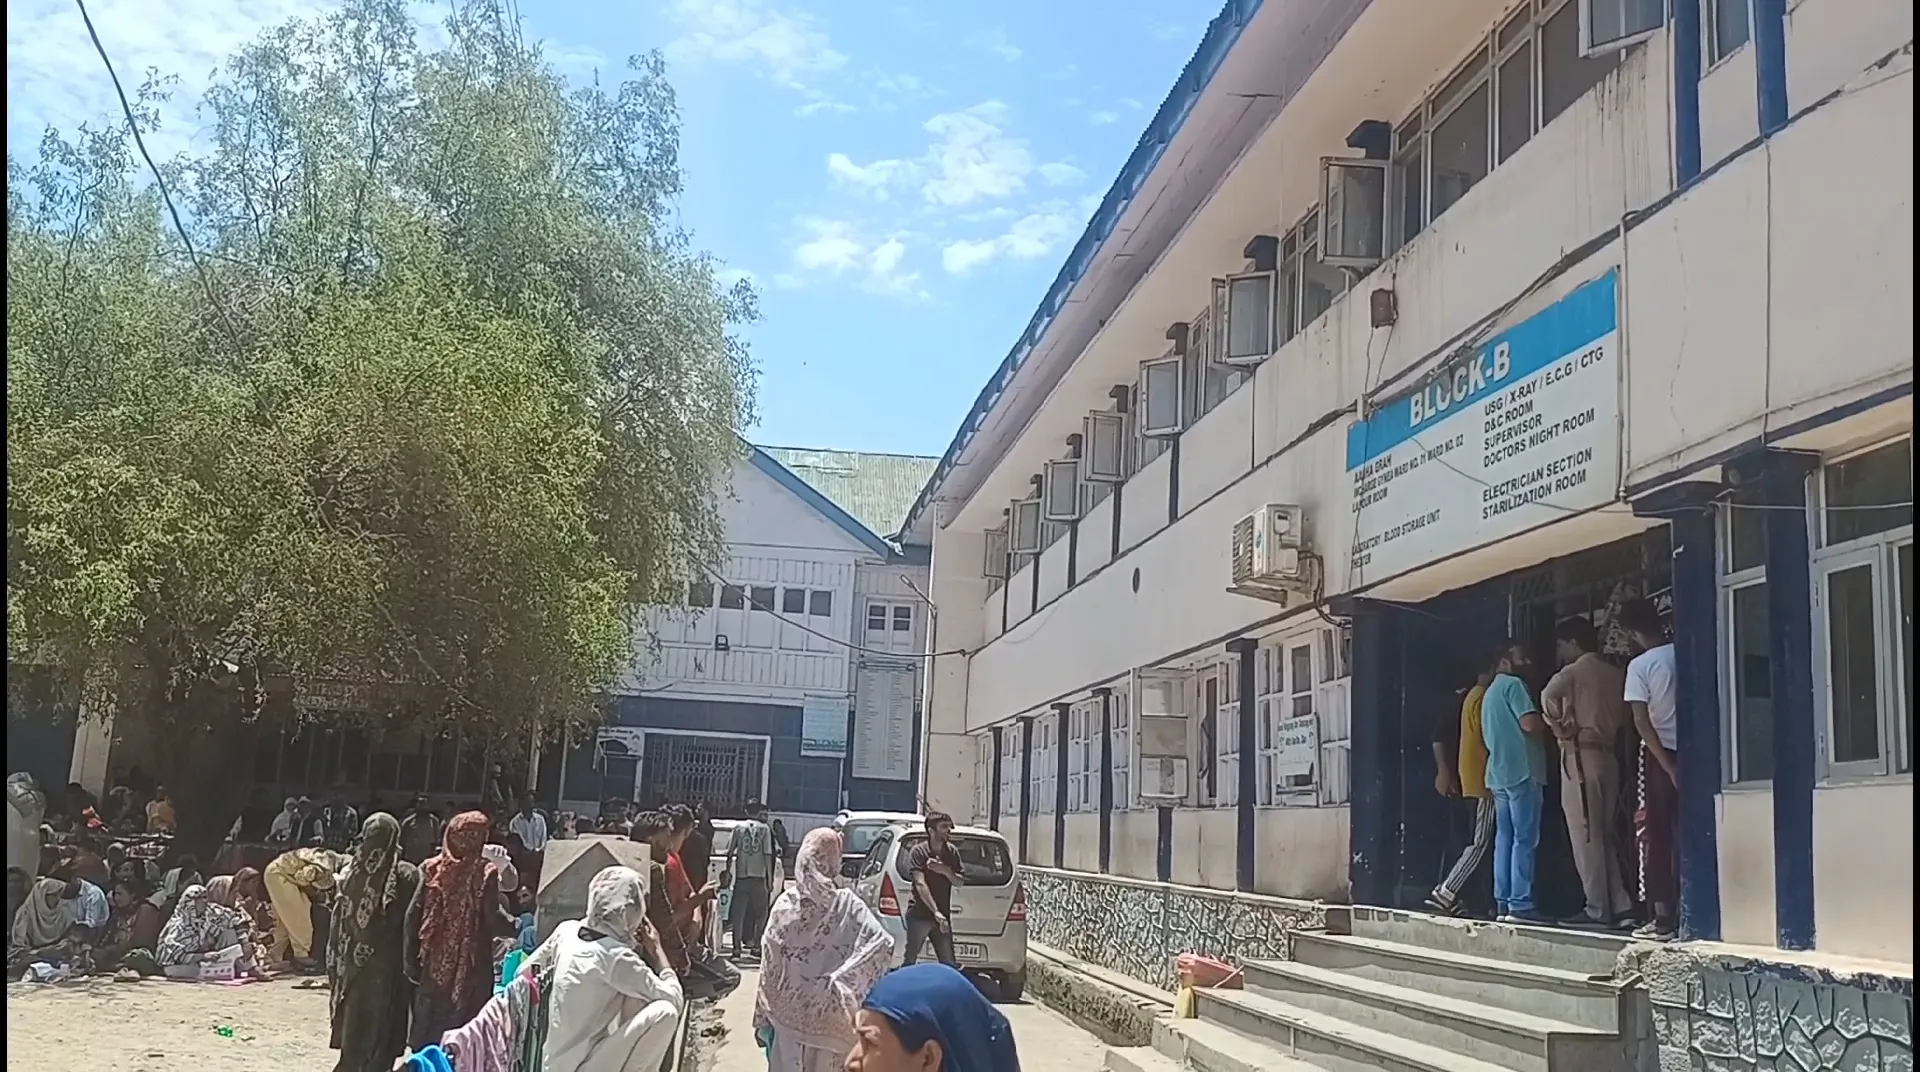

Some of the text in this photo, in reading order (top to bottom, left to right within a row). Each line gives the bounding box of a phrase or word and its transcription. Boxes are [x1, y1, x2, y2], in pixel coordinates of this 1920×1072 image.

[1410, 341, 1510, 428] BLOCK-B
[1484, 397, 1503, 416] USG
[1509, 378, 1538, 404] X-RAY
[1581, 346, 1604, 368] CTG
[1483, 407, 1595, 468] DOCTORS NIGHT ROOM
[1484, 400, 1534, 434] D&C ROOM
[1484, 413, 1543, 451] SUPERVISOR
[1482, 468, 1587, 520] STARILIZATION ROOM
[1483, 446, 1593, 502] ELECTRICIAN SECTION
